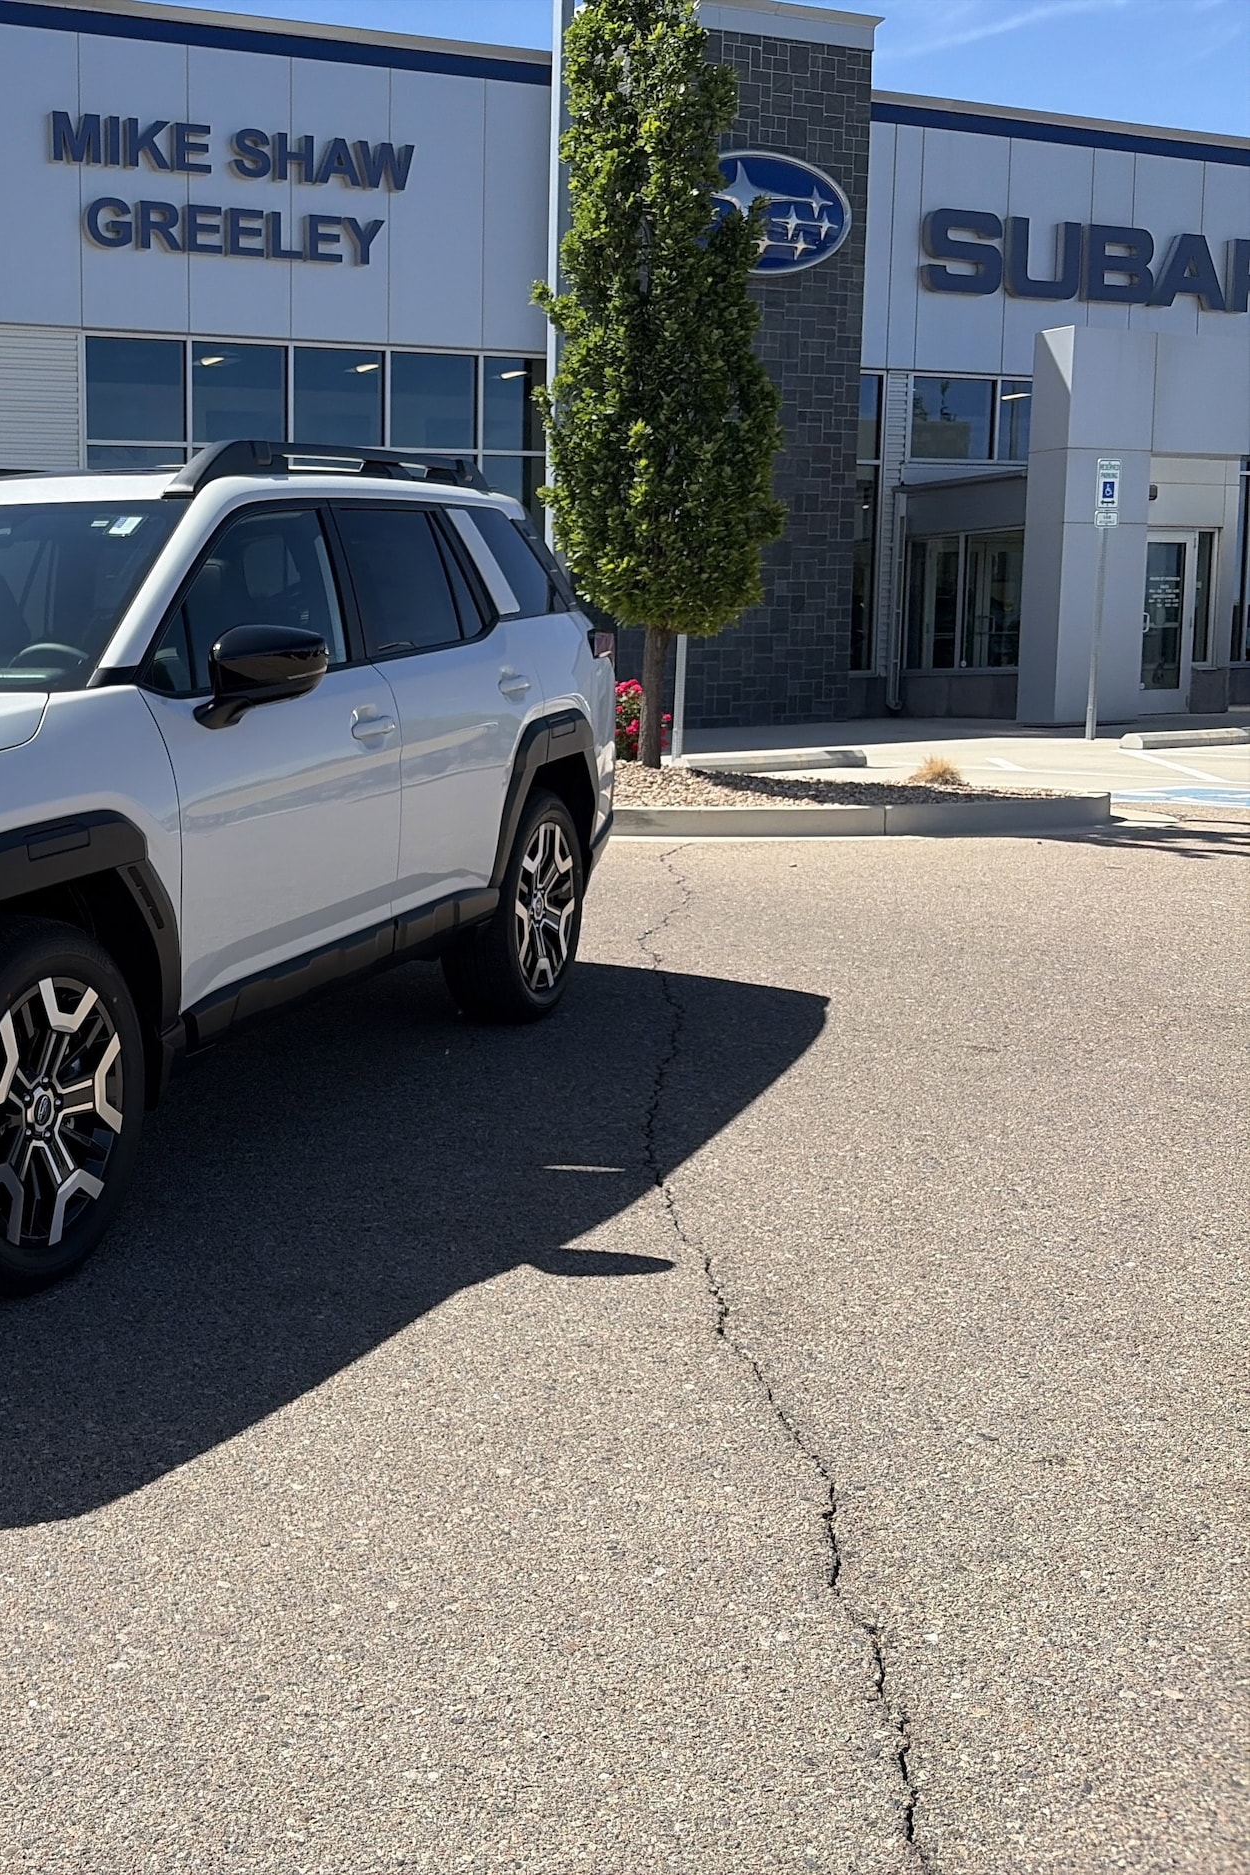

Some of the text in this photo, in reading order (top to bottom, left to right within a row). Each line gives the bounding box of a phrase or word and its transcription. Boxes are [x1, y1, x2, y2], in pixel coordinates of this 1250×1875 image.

[49, 110, 416, 193] MIKE SHAW
[83, 196, 385, 267] GREELEY
